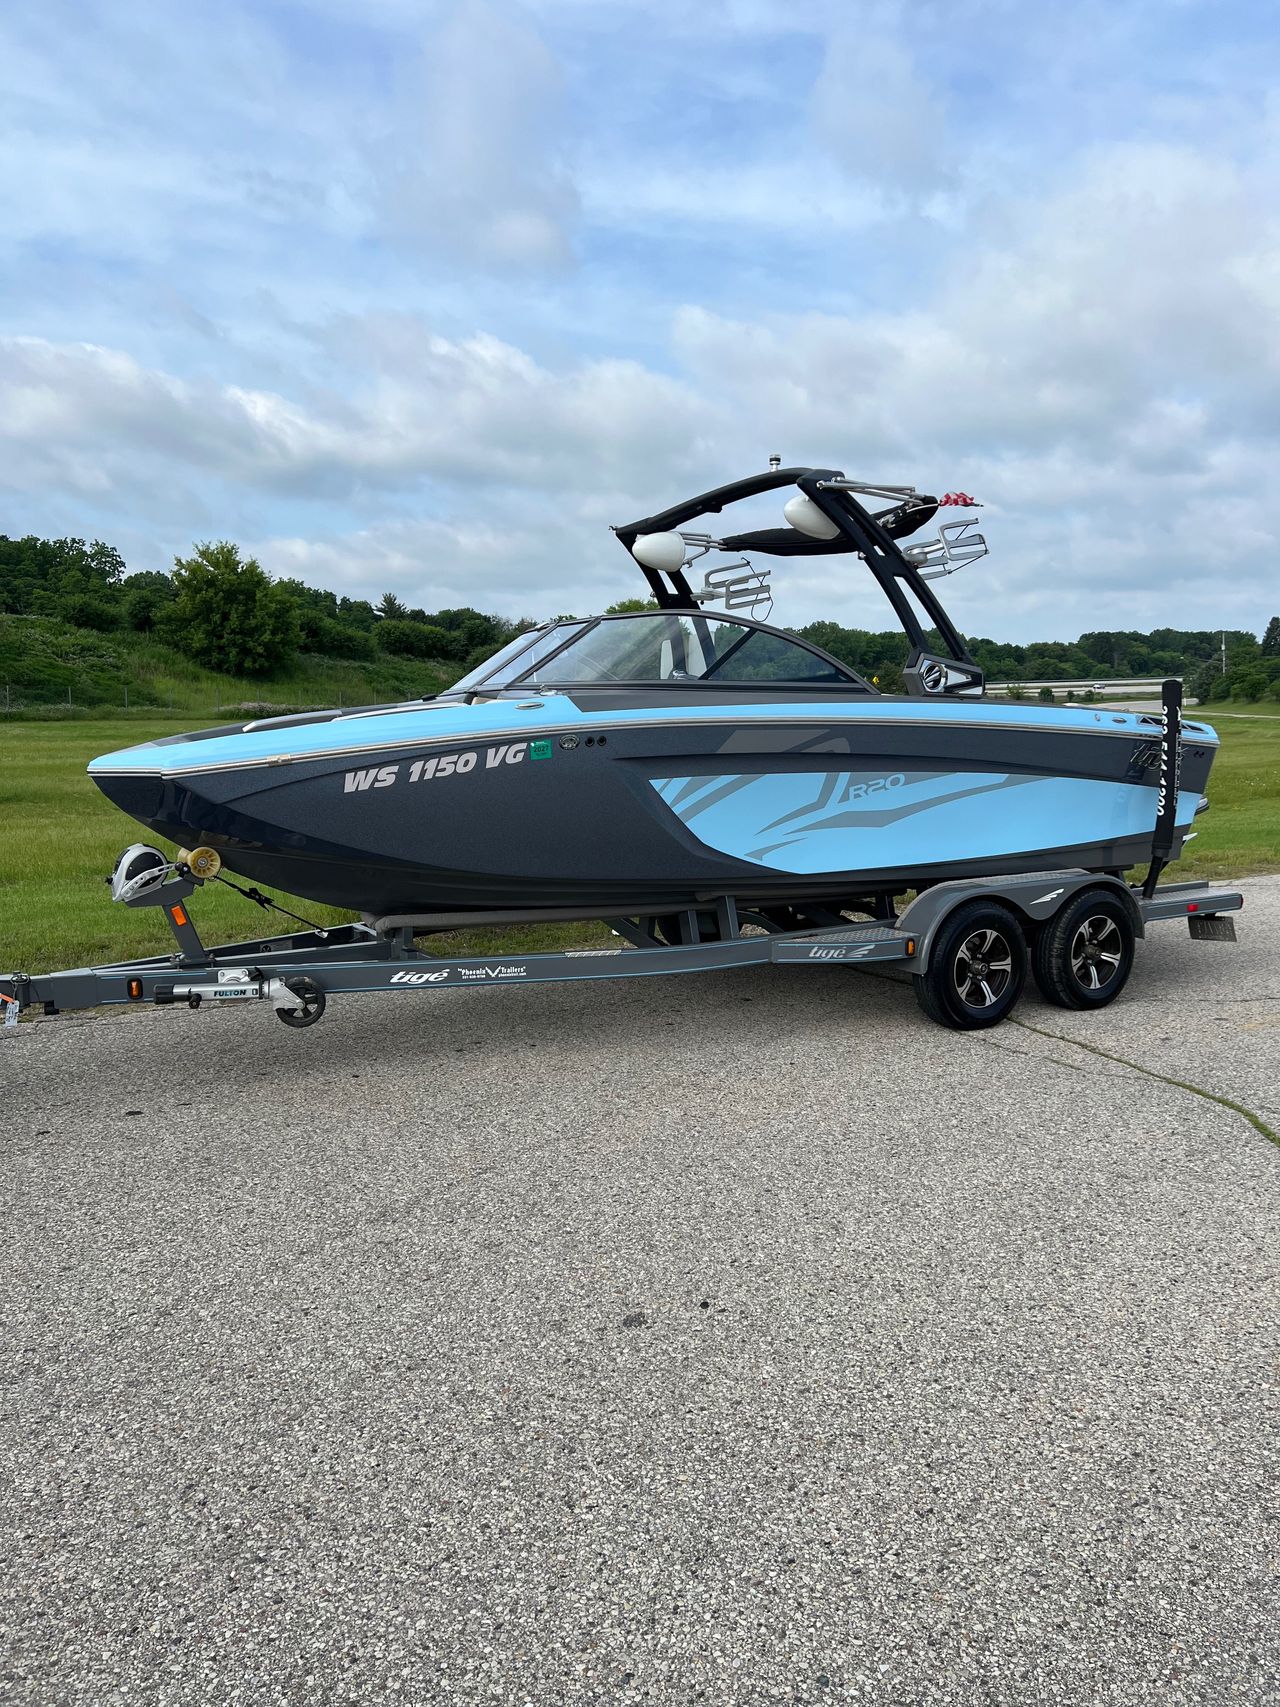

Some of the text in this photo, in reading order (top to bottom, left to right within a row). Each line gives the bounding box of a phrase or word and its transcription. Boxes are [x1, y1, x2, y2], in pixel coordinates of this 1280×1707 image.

[533, 744, 549, 753] 2027
[343, 742, 528, 793] WS 1150 VG
[848, 773, 905, 802] R20
[808, 946, 847, 959] tigé
[389, 968, 450, 985] tigé
[213, 989, 247, 997] FULTON
